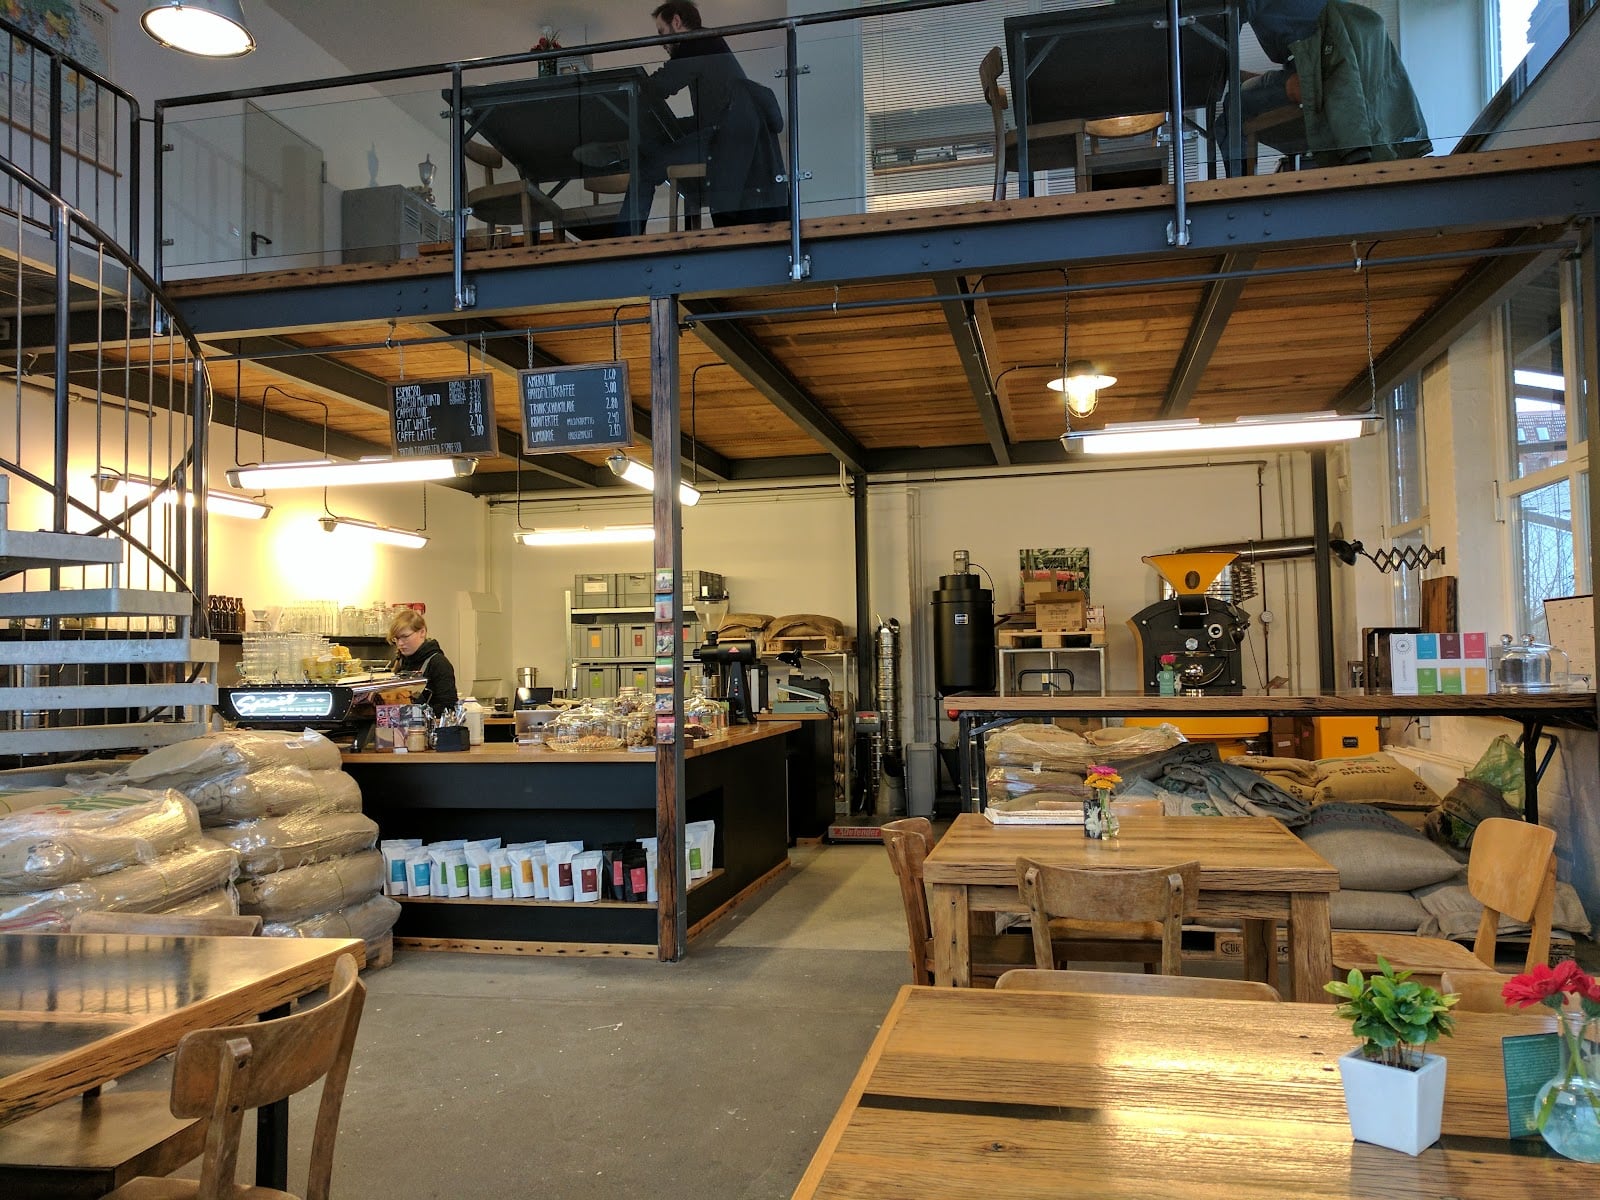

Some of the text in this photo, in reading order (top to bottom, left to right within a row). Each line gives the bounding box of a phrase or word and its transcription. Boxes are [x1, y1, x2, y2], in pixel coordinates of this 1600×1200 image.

[395, 385, 421, 398] ESPRESSO
[604, 381, 617, 394] 3.00
[396, 418, 411, 431] FLAT
[1341, 768, 1391, 776] BRASIL
